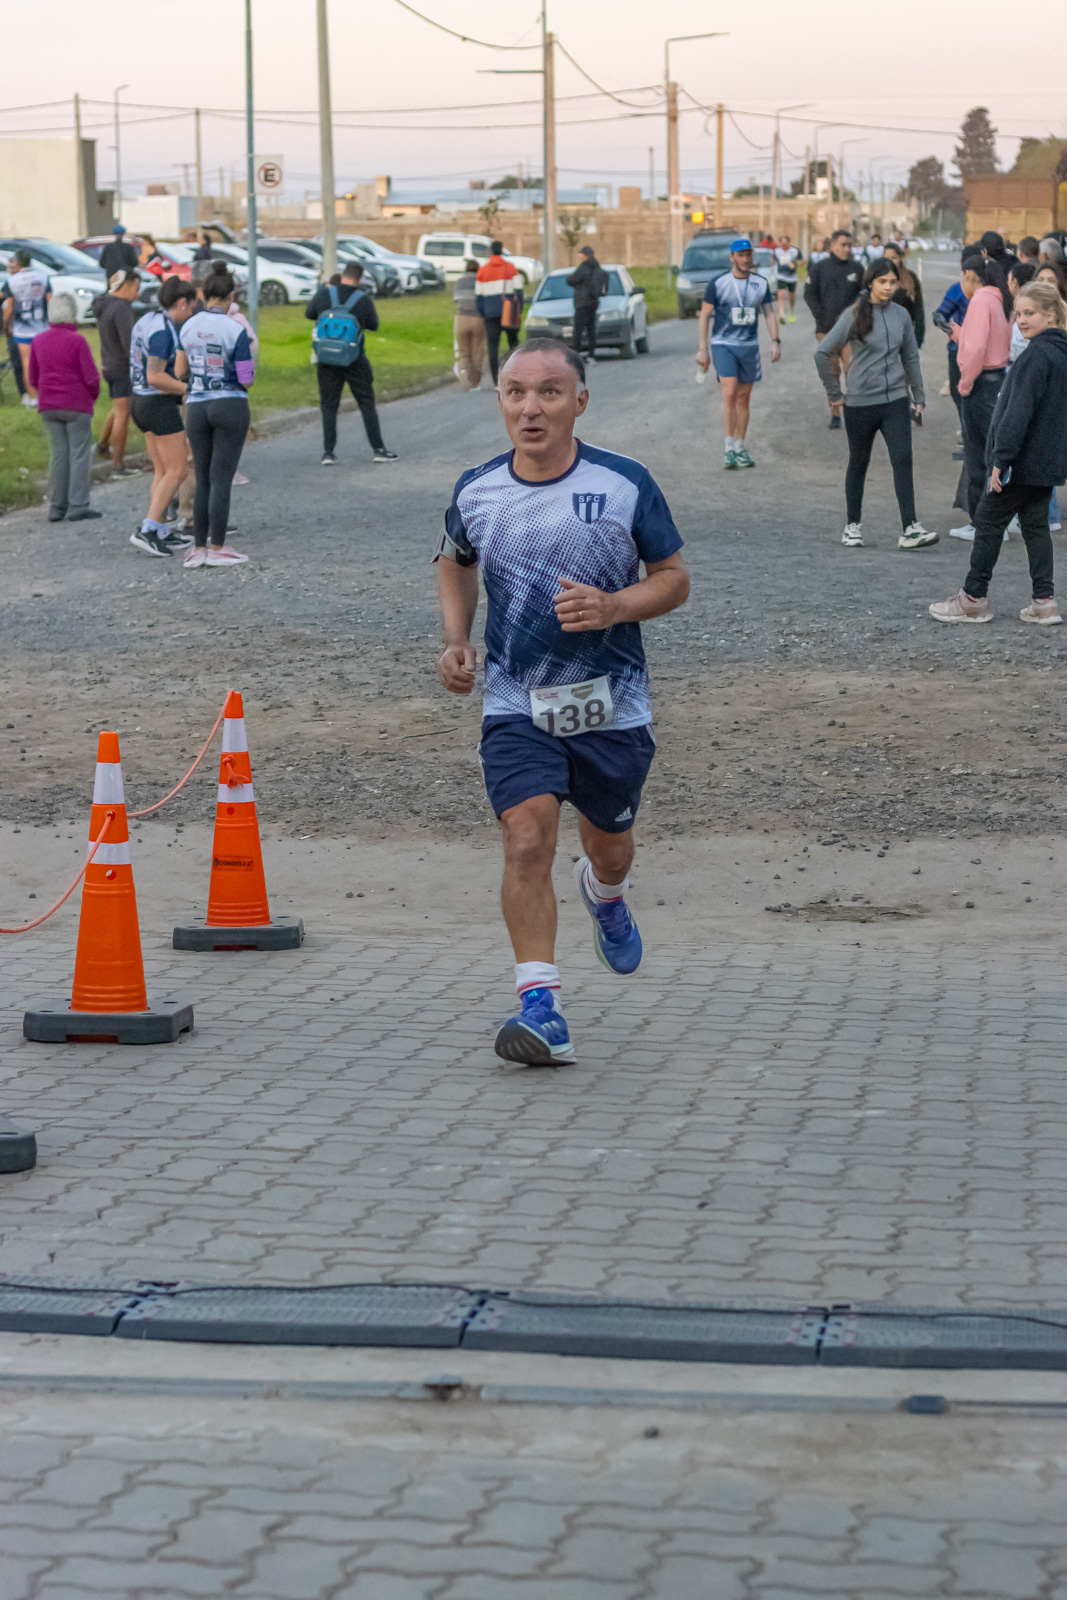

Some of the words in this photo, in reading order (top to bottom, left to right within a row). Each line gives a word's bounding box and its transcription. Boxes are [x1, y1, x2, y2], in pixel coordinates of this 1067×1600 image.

[263, 168, 276, 183] E
[578, 495, 601, 503] SFC
[539, 698, 606, 735] 138
